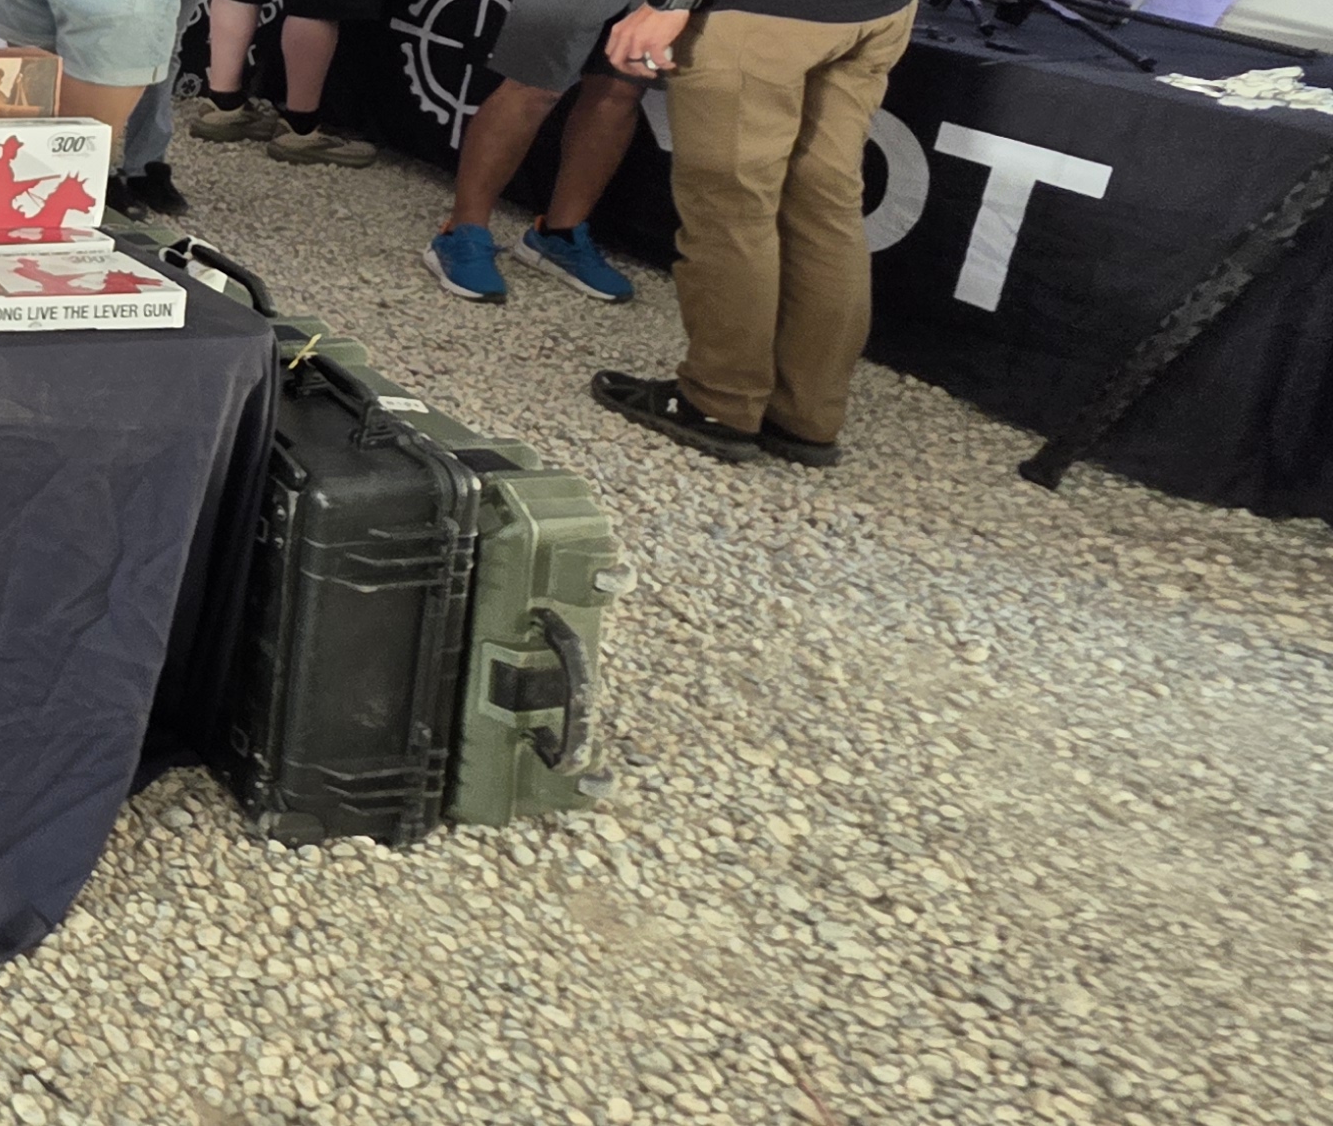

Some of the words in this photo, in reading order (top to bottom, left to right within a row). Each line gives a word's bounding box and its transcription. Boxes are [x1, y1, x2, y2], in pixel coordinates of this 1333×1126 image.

[51, 136, 86, 153] 300
[27, 306, 58, 321] LIVE
[62, 305, 90, 320] THE
[93, 304, 138, 319] LEVER
[143, 303, 173, 318] GUN
